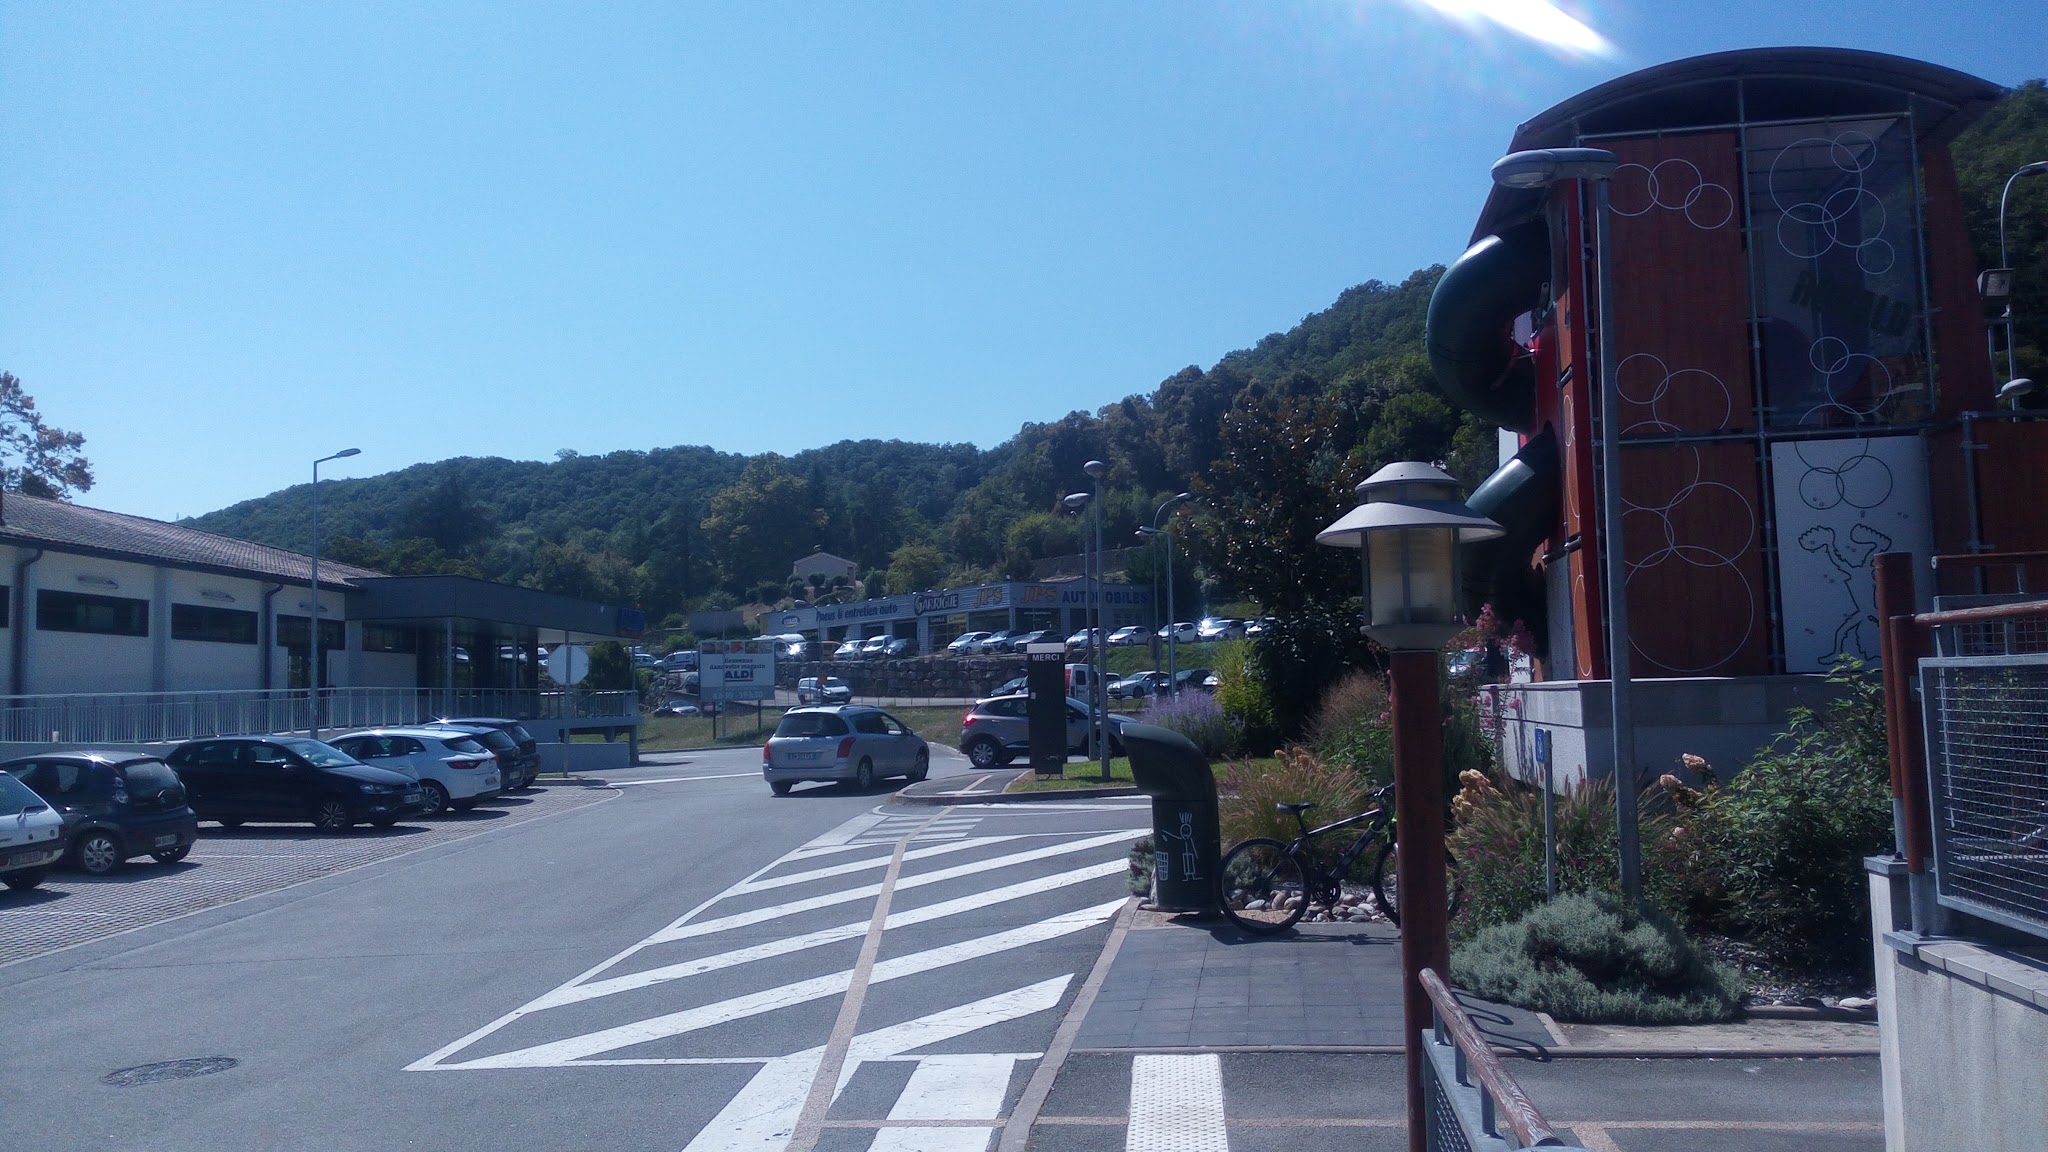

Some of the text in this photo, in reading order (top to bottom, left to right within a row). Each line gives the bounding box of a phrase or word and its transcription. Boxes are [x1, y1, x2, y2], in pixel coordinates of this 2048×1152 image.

[976, 588, 1003, 608] JPS
[1024, 586, 1148, 604] JPS AUTOOBILES
[845, 605, 877, 618] entretien
[879, 603, 898, 614] auto
[915, 594, 958, 614] GARRIGUE
[1032, 653, 1060, 661] MERCI
[724, 670, 754, 679] ALDI
